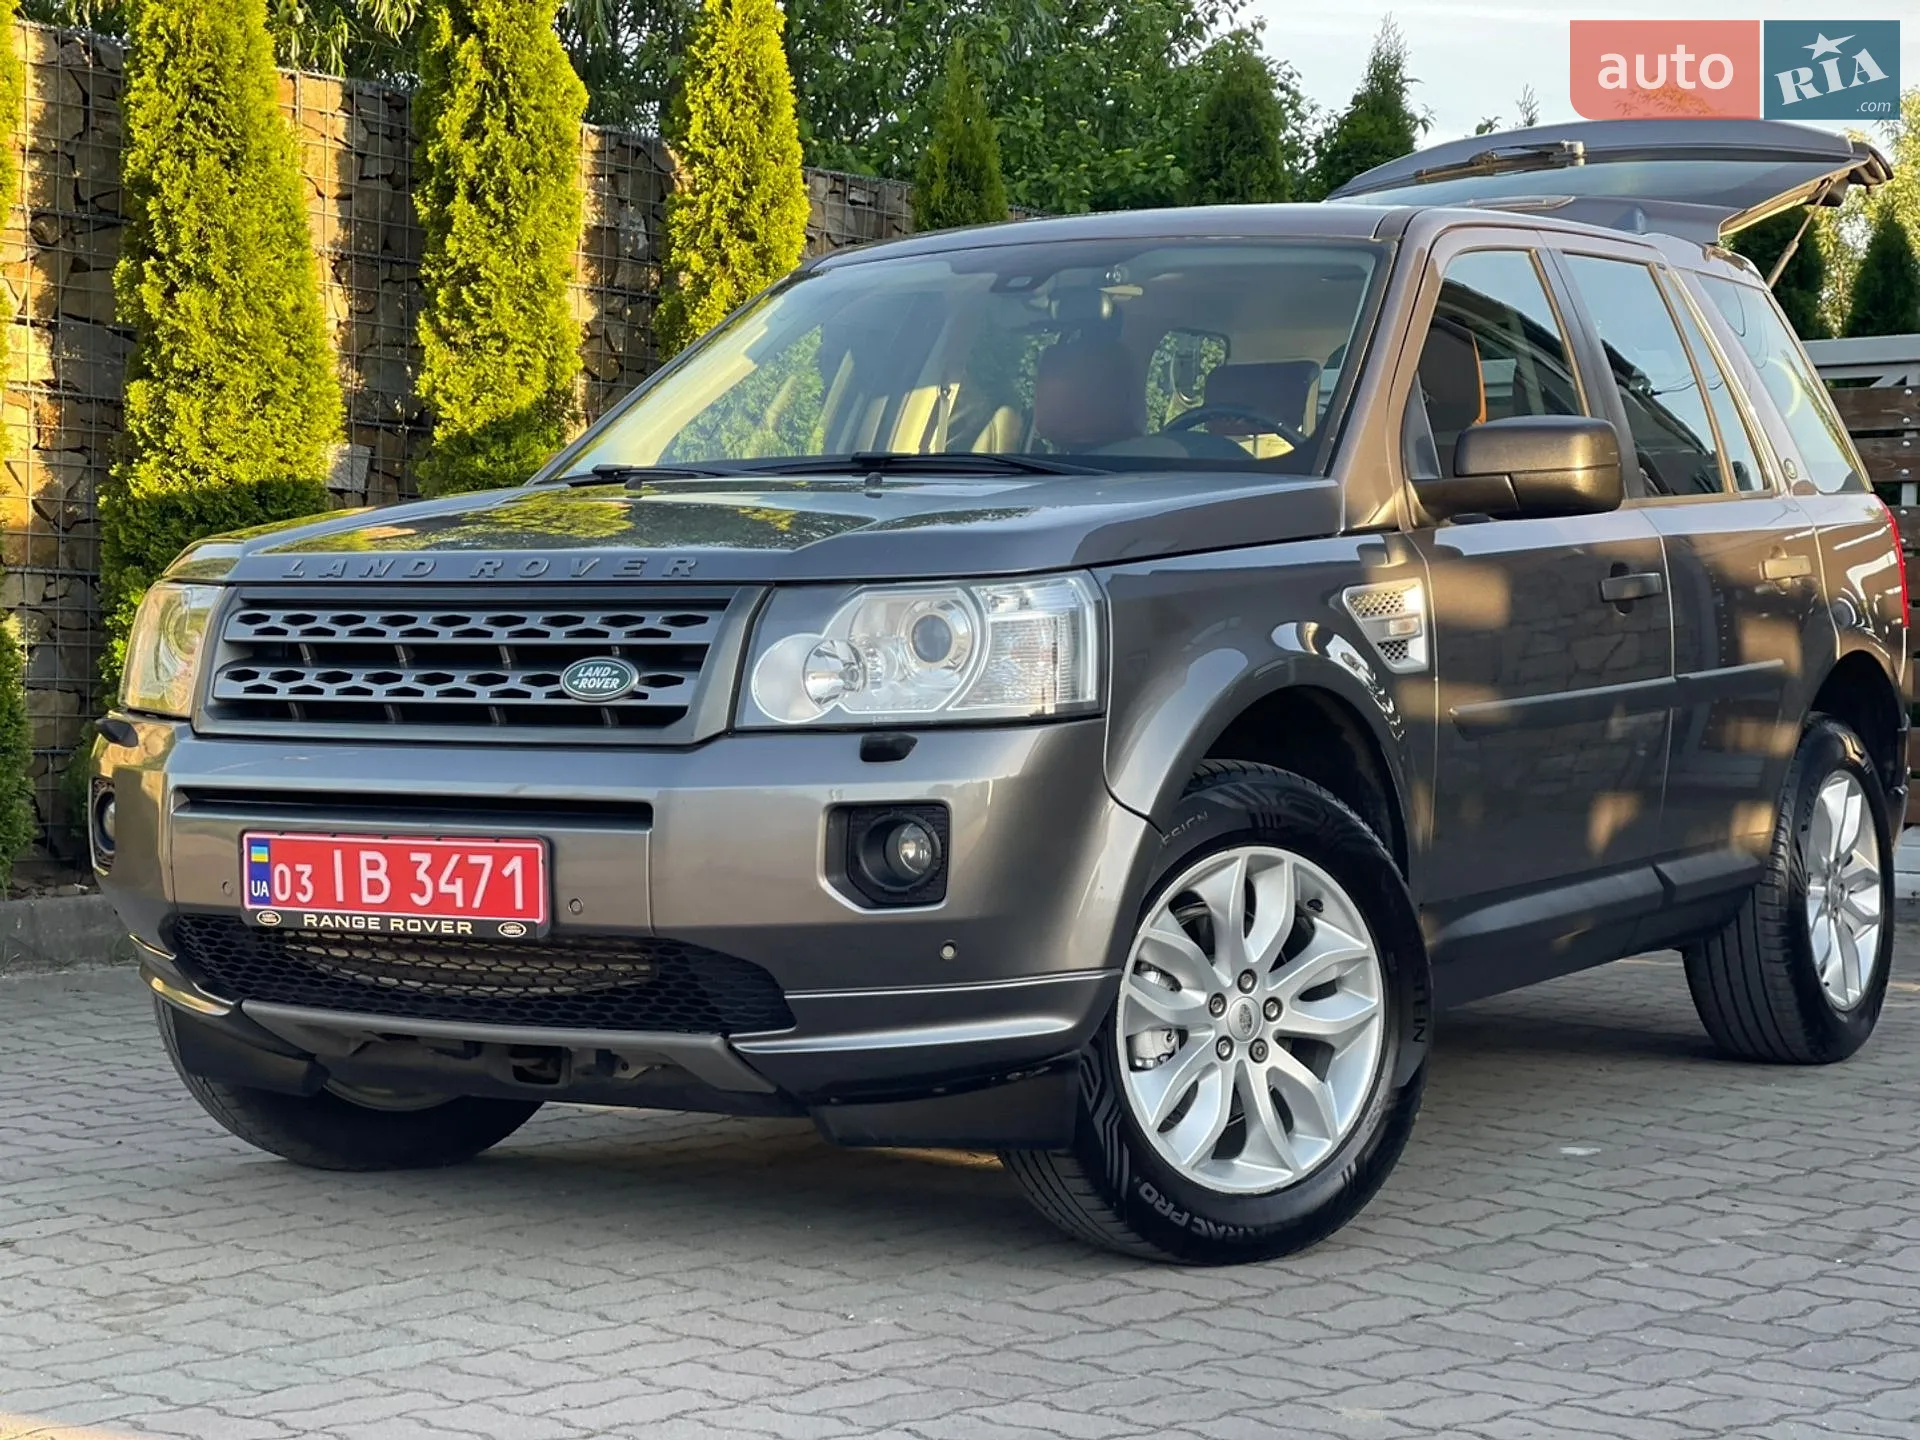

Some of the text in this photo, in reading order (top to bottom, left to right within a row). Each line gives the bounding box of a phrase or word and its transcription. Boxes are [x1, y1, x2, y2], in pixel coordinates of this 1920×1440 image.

[281, 556, 698, 578] LAND ROVER
[251, 880, 270, 897] UA
[273, 849, 524, 910] 03 IB 3471
[303, 913, 473, 935] RANGE ROVER
